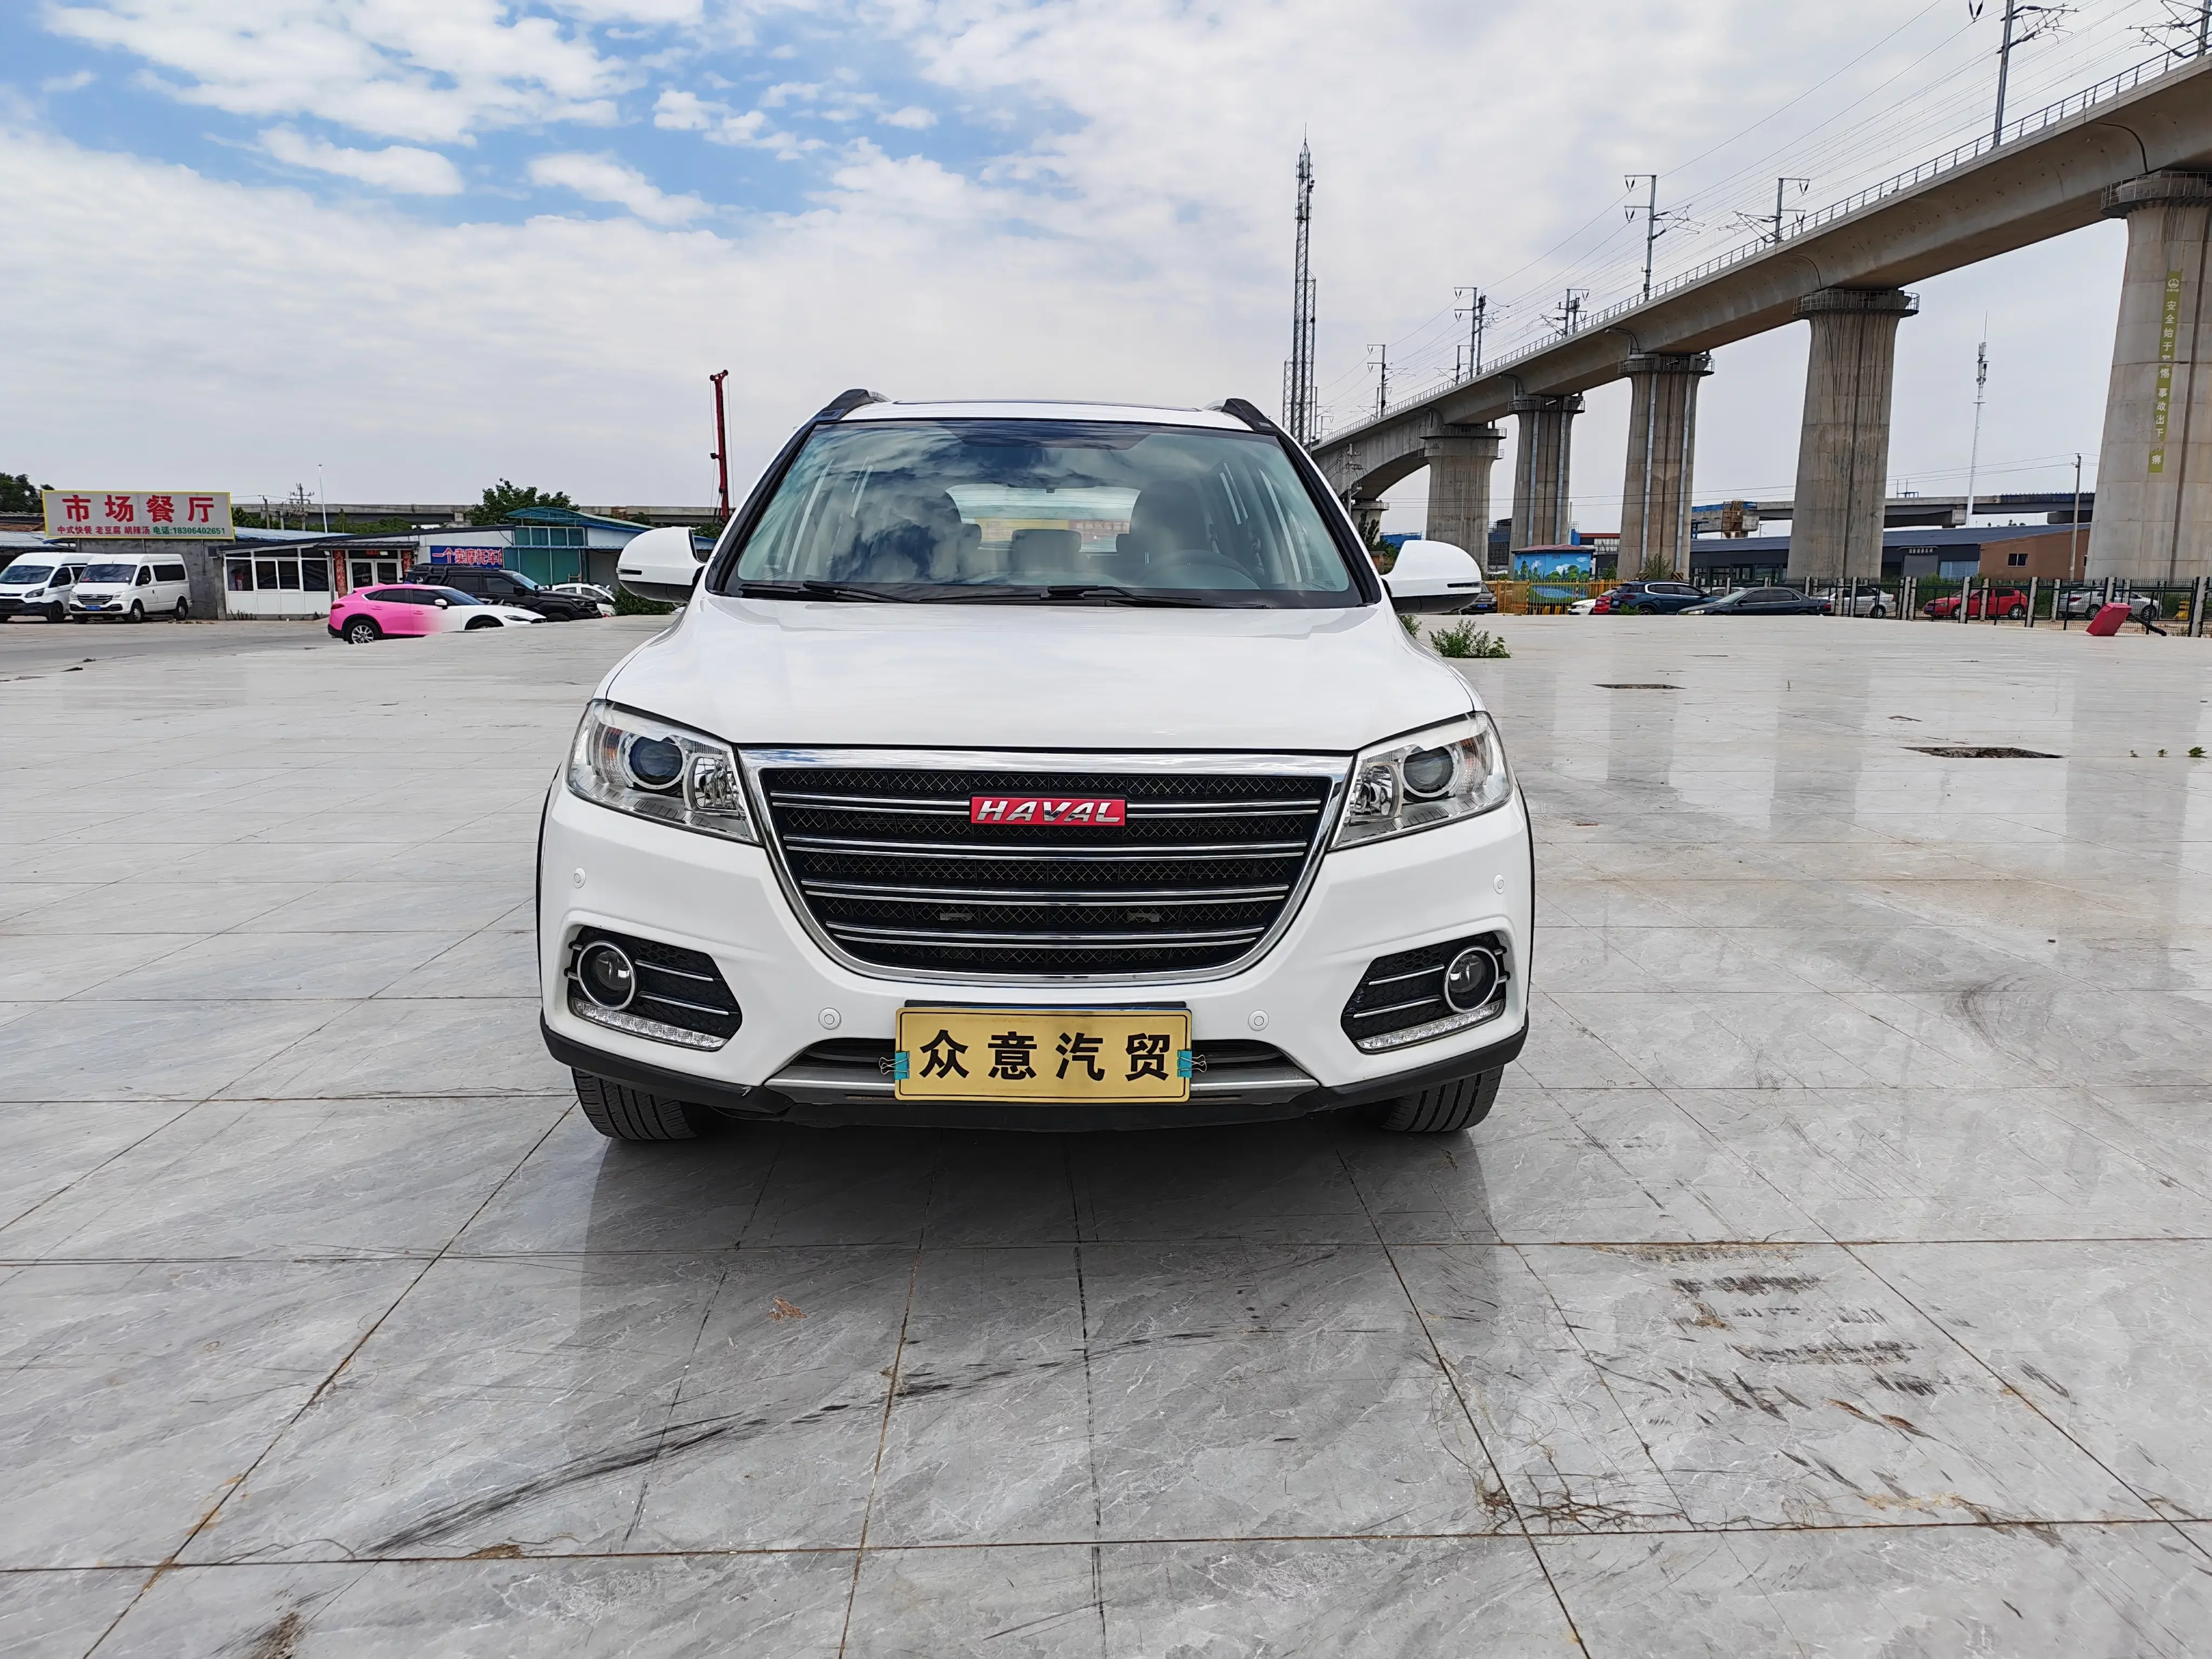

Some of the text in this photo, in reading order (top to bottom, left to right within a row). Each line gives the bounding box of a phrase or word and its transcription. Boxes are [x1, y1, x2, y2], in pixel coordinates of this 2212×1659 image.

[62, 494, 214, 523] 市场餐厅
[57, 525, 92, 534] 中式快餐
[95, 526, 121, 534] 老豆腐
[124, 526, 150, 534] 胡辣汤
[976, 800, 1121, 822] HAVAL
[919, 1029, 1171, 1081] 众意汽贸
